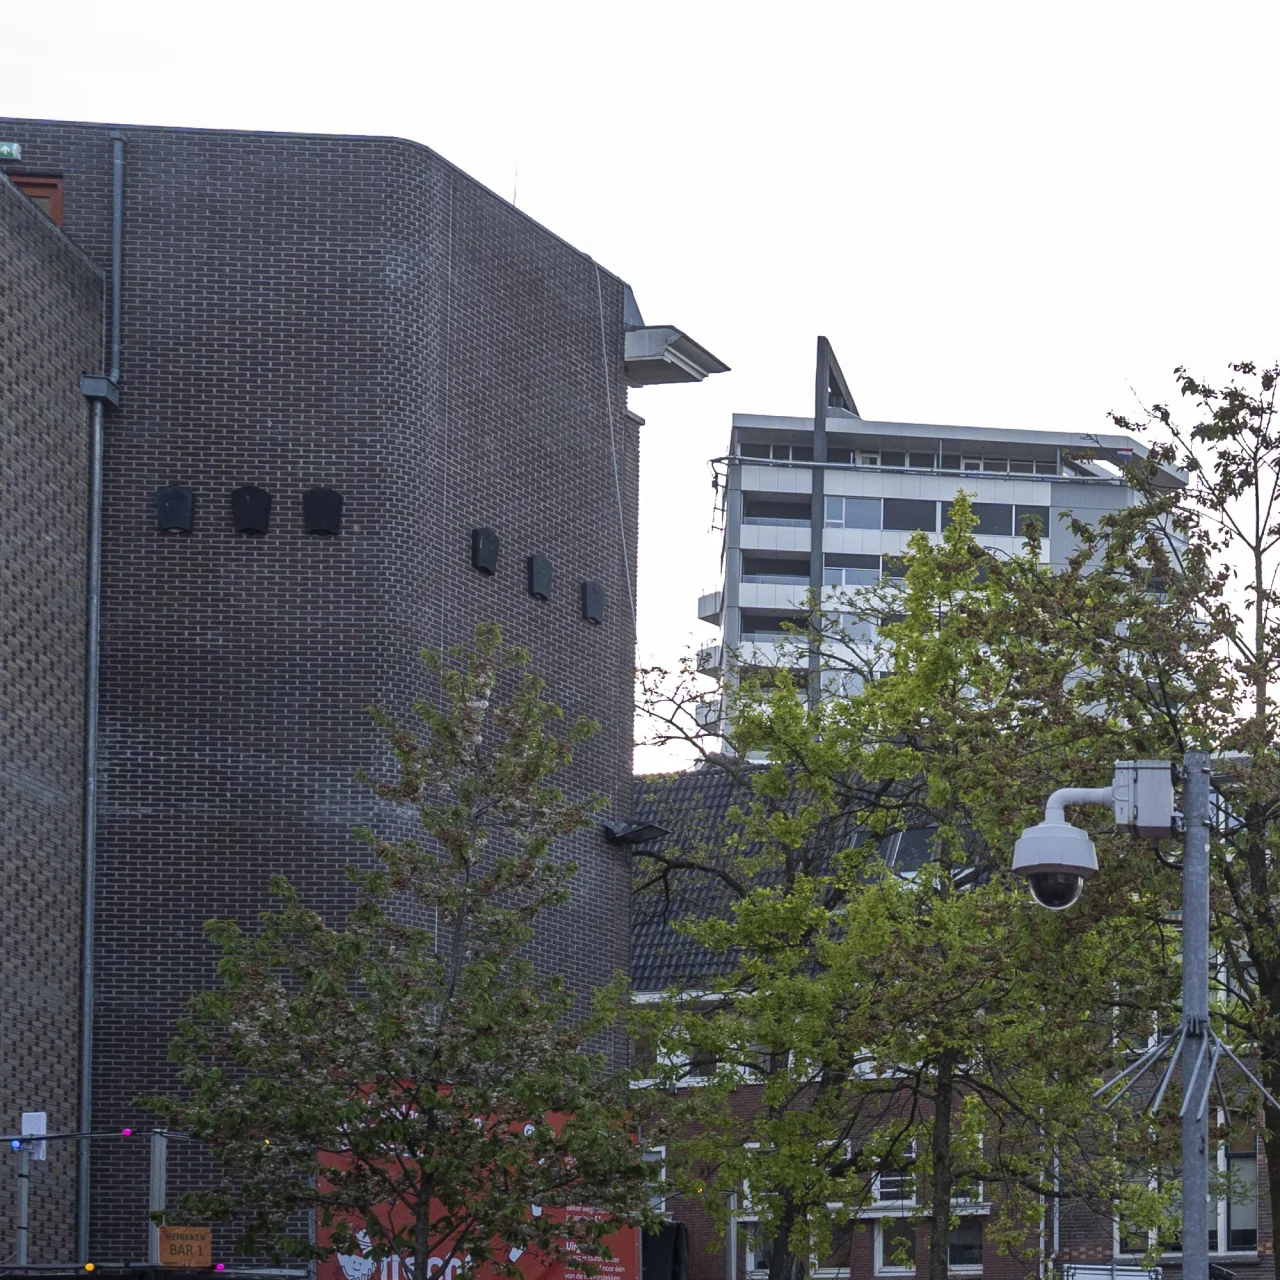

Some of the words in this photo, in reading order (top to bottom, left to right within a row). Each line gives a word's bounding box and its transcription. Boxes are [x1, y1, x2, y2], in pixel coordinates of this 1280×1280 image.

[165, 1233, 206, 1241] HEINEKEN
[170, 1243, 194, 1256] BAR
[197, 1244, 204, 1256] 1
